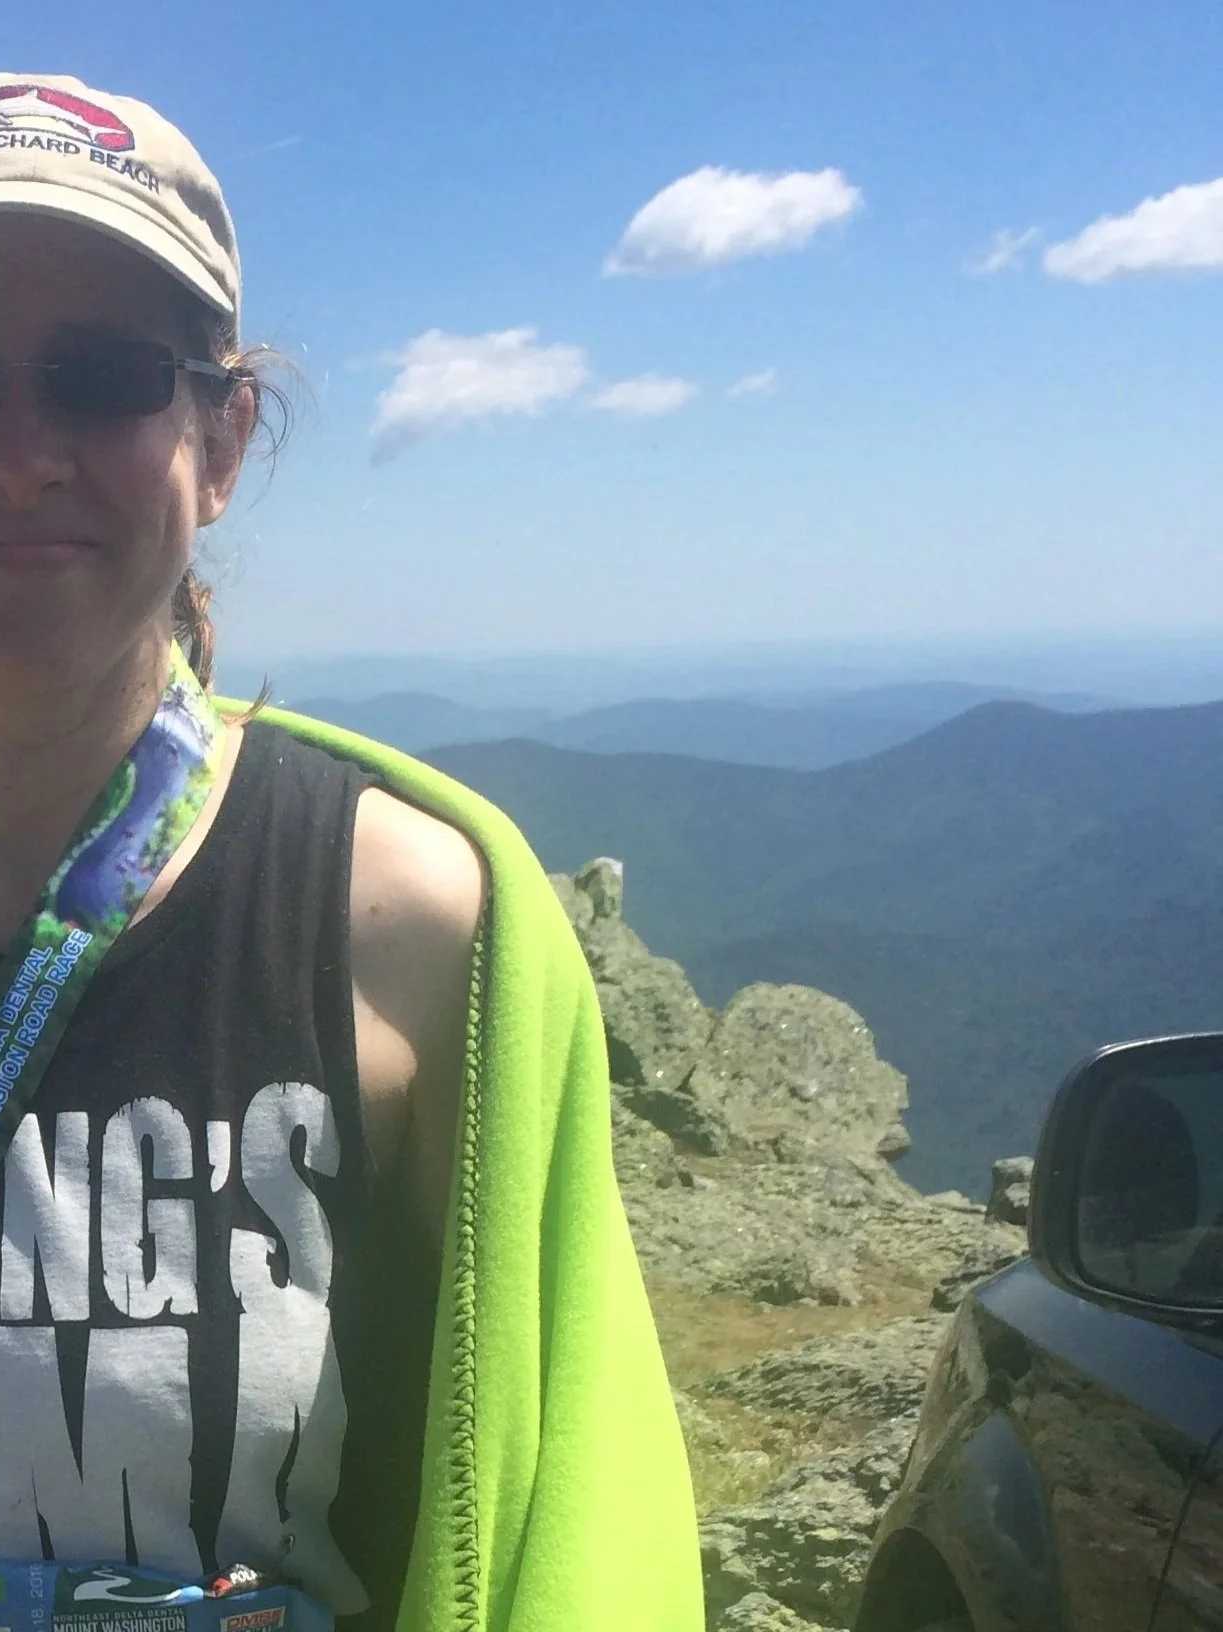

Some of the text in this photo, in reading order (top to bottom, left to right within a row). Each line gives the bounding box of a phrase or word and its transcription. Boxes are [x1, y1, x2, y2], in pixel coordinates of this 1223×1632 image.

[89, 148, 161, 195] BEACH
[15, 984, 59, 1049] ROAD
[44, 927, 94, 986] RACE
[52, 1607, 185, 1624] NORTHEAST DELTA DENTAL
